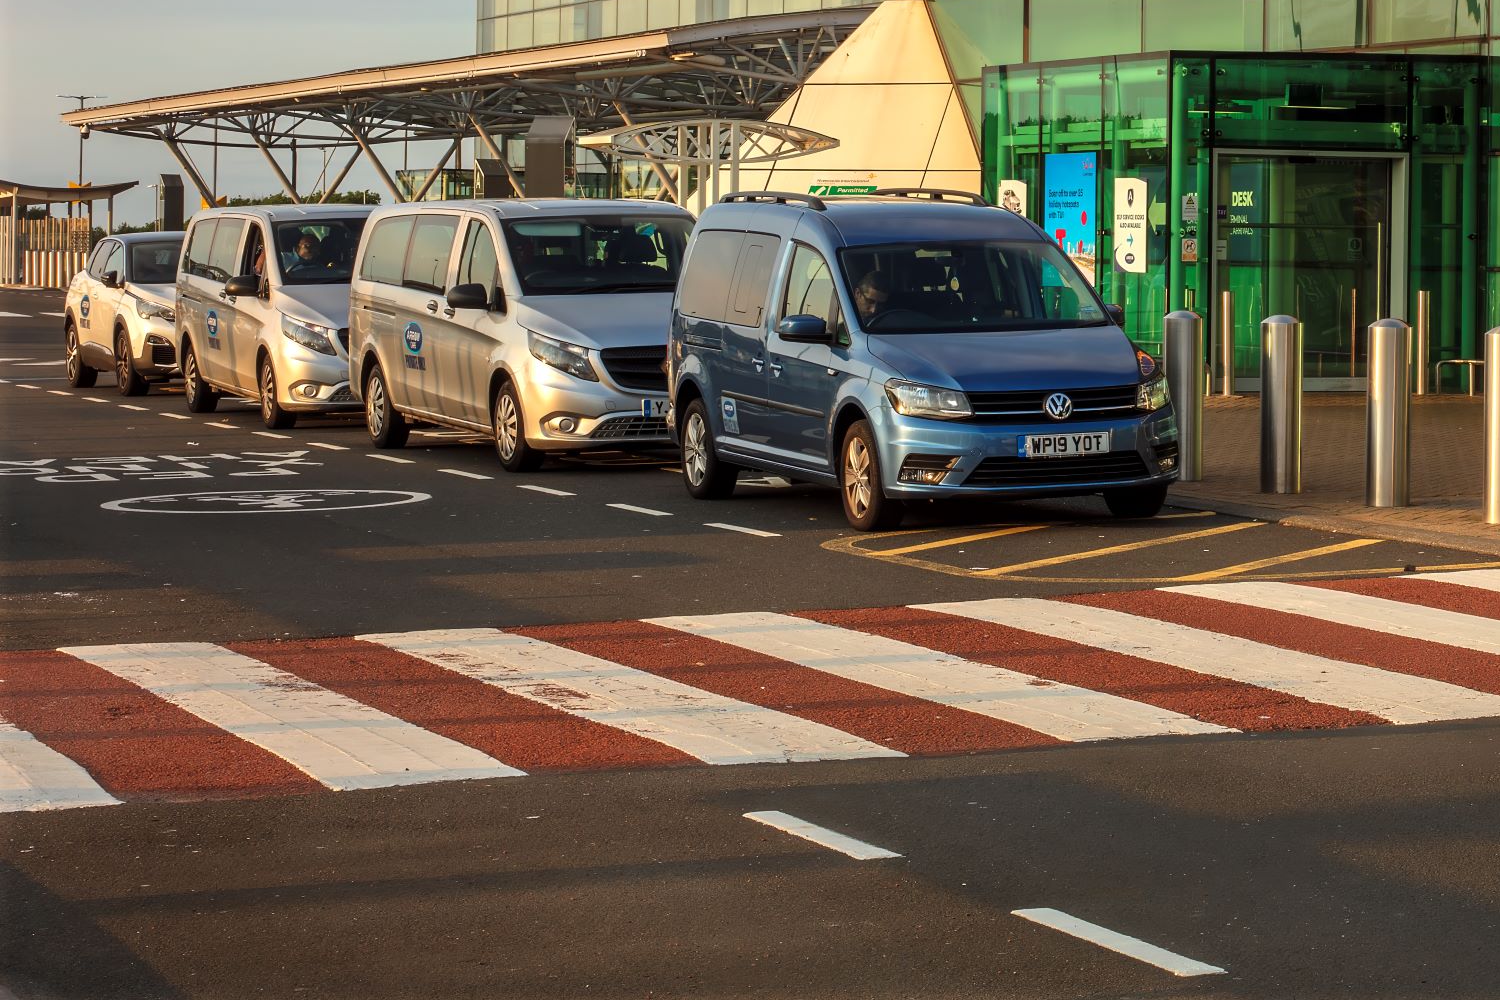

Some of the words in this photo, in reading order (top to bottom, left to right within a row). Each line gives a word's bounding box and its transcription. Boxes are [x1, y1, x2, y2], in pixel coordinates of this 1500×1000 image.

[1232, 191, 1253, 206] DESK
[1031, 436, 1068, 453] WP19
[1072, 435, 1103, 452] YOT
